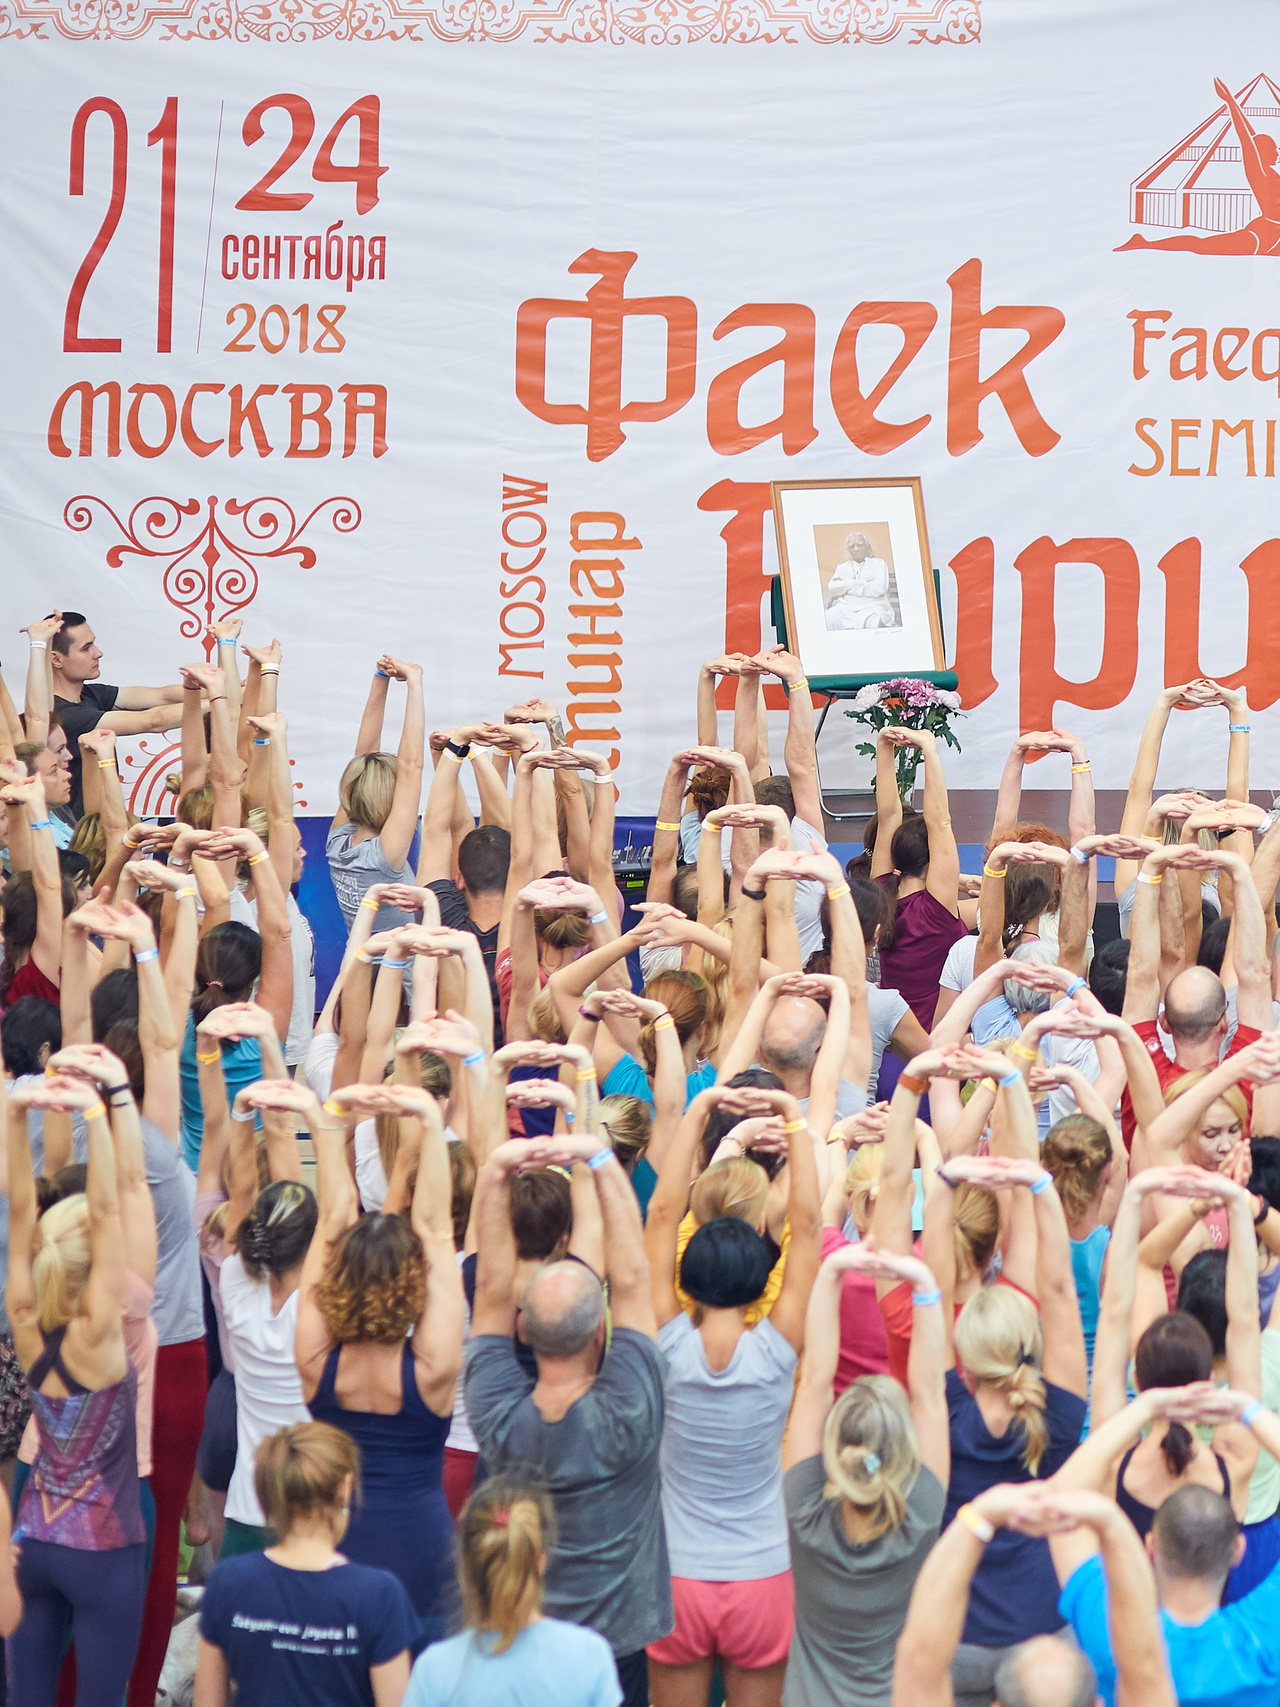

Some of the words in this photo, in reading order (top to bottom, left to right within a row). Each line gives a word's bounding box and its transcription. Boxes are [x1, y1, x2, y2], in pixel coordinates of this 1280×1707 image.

[62, 96, 178, 354] 21
[235, 94, 389, 216] 24
[221, 219, 386, 293] сентября
[47, 380, 389, 459] МОСКВА
[223, 303, 346, 354] 2018
[515, 248, 1066, 463] Фаек
[498, 473, 548, 680] MOSCOW
[565, 511, 643, 803] минар
